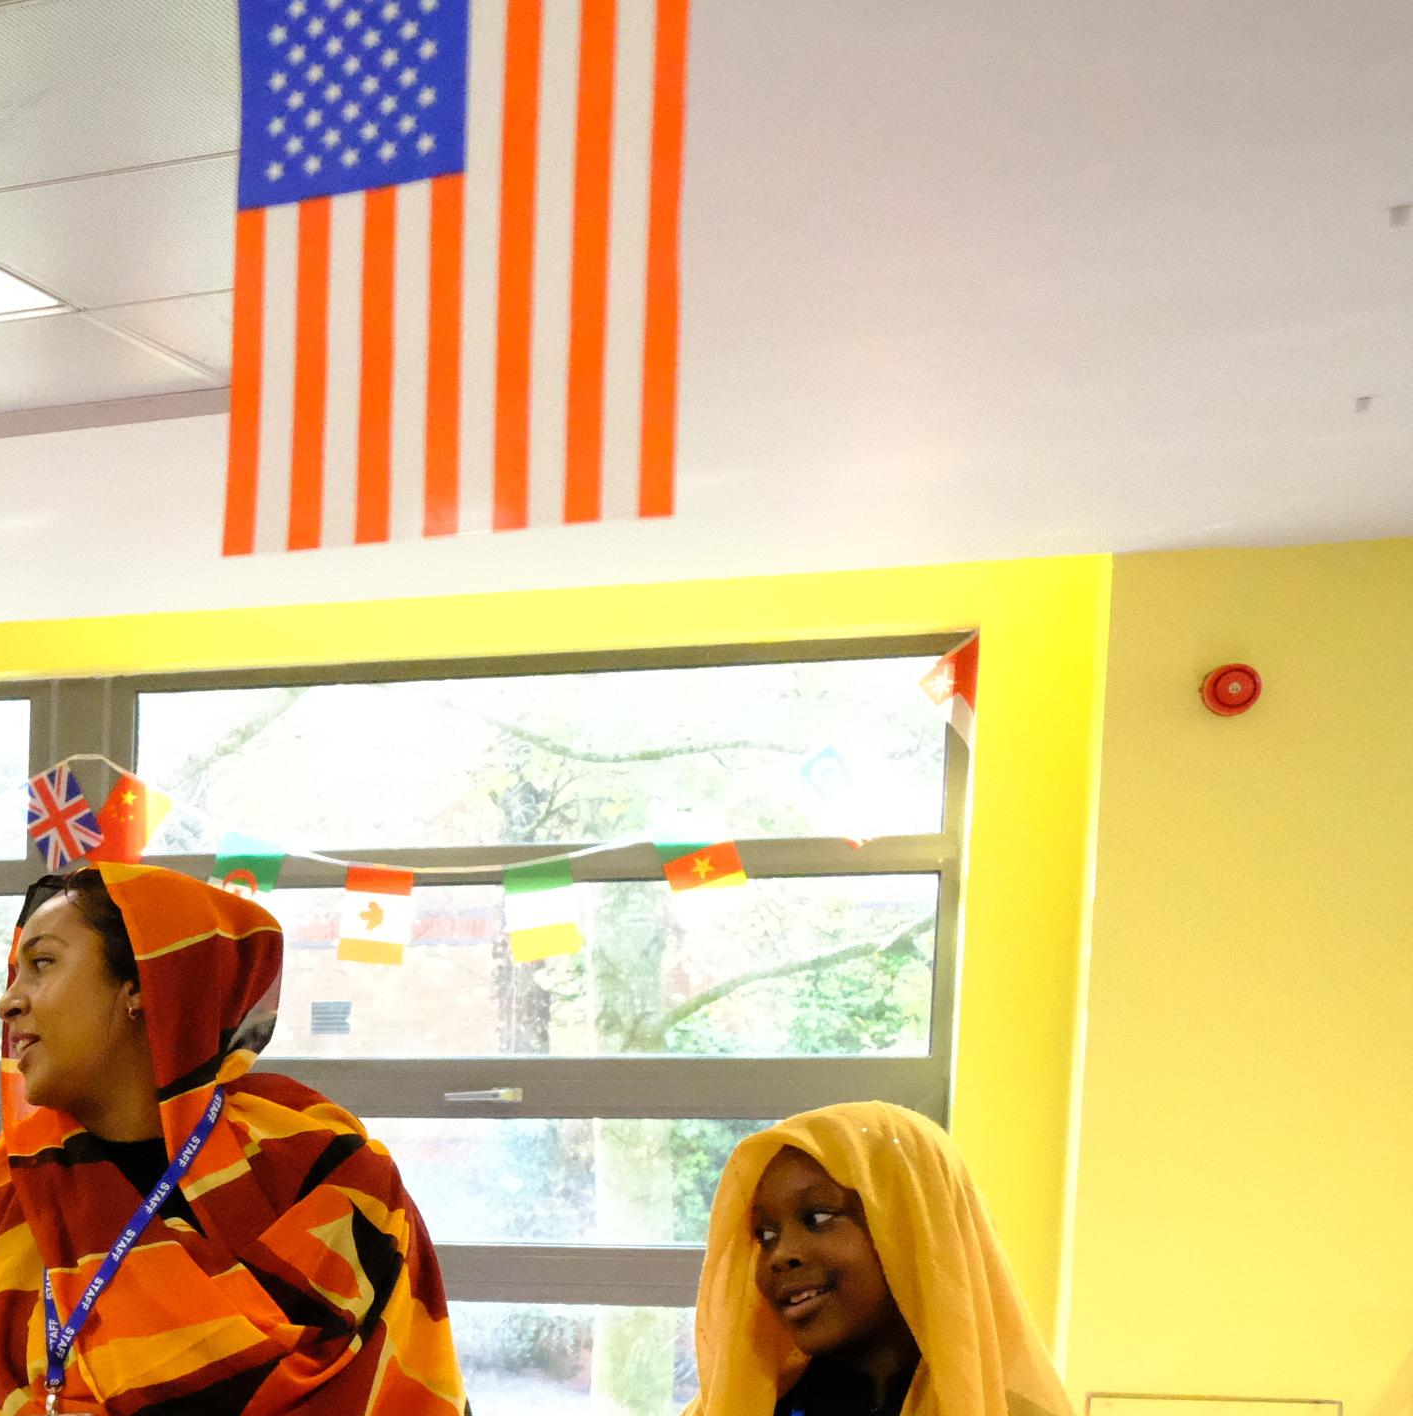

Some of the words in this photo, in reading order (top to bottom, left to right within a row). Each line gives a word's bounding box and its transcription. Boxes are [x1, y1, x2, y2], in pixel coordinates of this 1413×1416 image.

[208, 1094, 222, 1124] STAFF
[178, 1135, 201, 1168] STAFF
[144, 1181, 171, 1214] STAFF
[111, 1228, 137, 1262] STAFF
[82, 1277, 105, 1311] STAFF
[55, 1326, 75, 1360] STAFF
